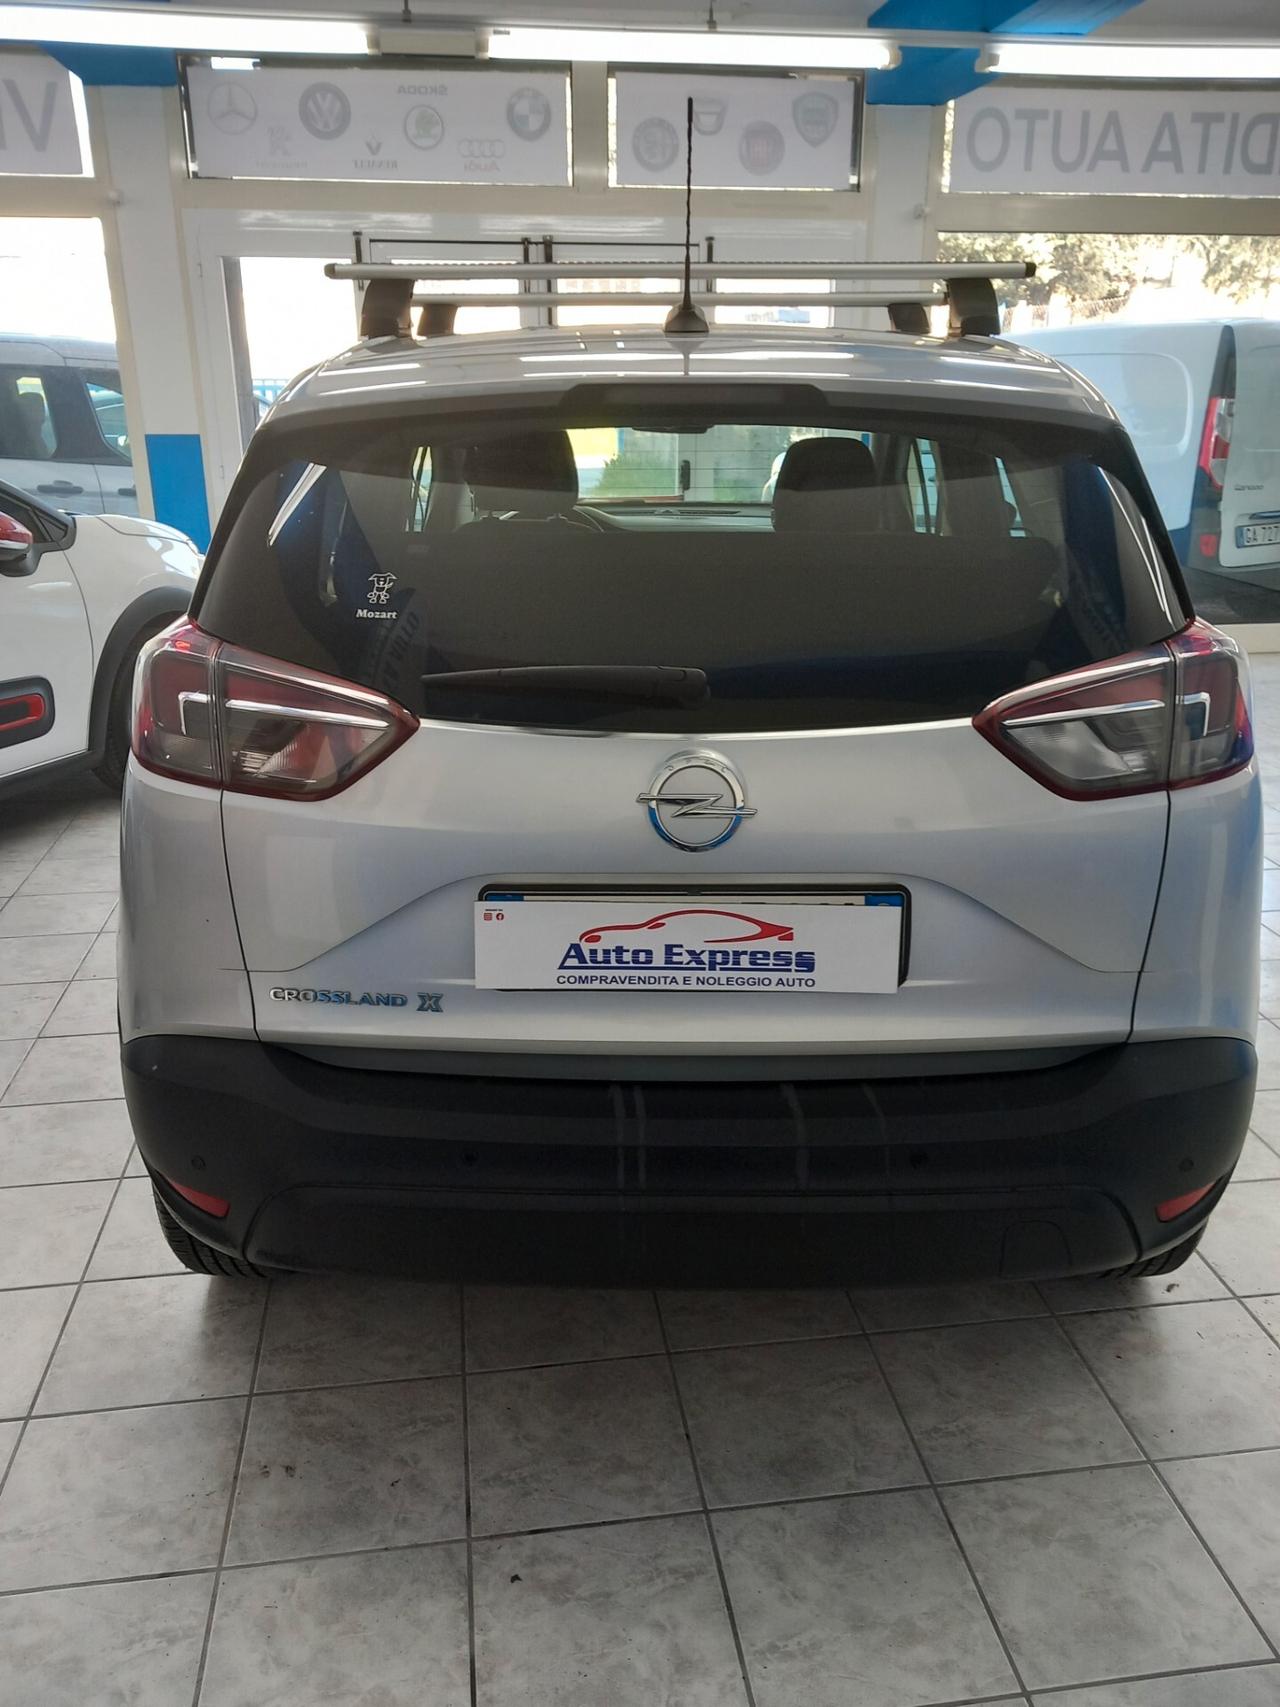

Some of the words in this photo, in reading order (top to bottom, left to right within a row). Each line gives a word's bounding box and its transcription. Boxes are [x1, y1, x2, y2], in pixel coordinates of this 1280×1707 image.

[356, 609, 398, 619] Mozart
[557, 943, 654, 970] Auto
[663, 943, 816, 973] Express
[556, 975, 679, 985] COMPRAVENDITA
[682, 976, 692, 986] E
[695, 976, 772, 987] NOLEGGIO
[775, 977, 816, 988] AUTO
[269, 987, 409, 1008] CROSSLAND
[416, 992, 444, 1013] X
